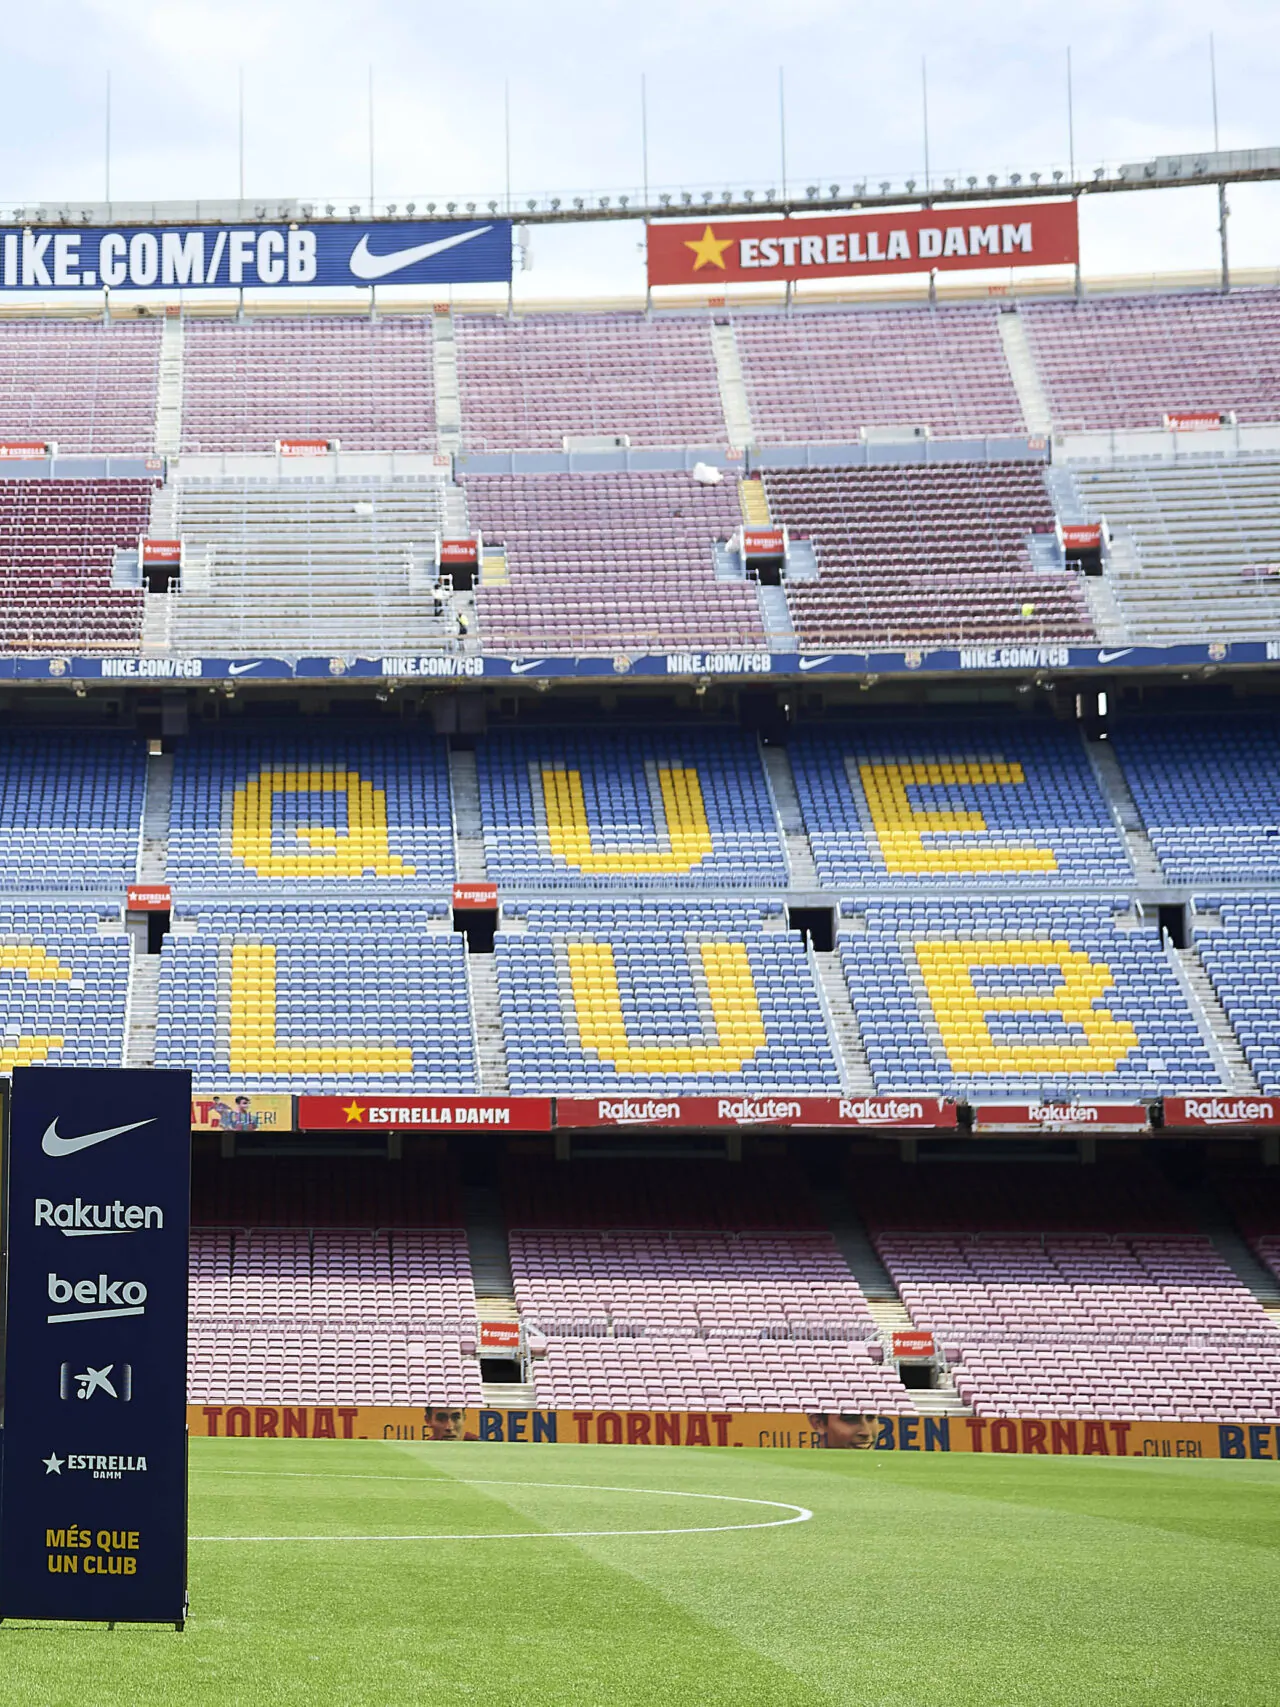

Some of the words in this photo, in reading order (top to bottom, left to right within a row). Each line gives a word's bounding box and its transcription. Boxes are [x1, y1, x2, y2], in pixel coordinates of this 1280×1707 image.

[740, 230, 911, 268] ESTRELLA
[918, 222, 1032, 259] DAMM
[101, 659, 202, 677] NIKE.COM/FCB
[381, 657, 484, 676] NIKE.COM/FCB
[666, 653, 771, 673] NIKE.COM/FCB
[960, 648, 1069, 669] NIKE.COM/FCB
[232, 762, 1058, 877] QUE
[228, 1110, 276, 1125] CULER!
[368, 1107, 451, 1123] ESTRELLA
[455, 1108, 509, 1124] DAMM
[598, 1101, 680, 1119] Rakuten
[718, 1101, 801, 1119] Rakuten
[839, 1100, 923, 1118] Rakuten
[1028, 1105, 1098, 1121] Rakuten
[1185, 1101, 1273, 1119] Rakuten
[35, 1198, 163, 1229] Rakuten
[48, 1273, 147, 1305] beko
[479, 1410, 557, 1443] BEN
[874, 1416, 950, 1451] BEN
[1218, 1425, 1280, 1460] BE
[68, 1455, 147, 1471] ESTRELLA
[93, 1471, 122, 1479] DAMM
[46, 1524, 91, 1548] MÉS
[96, 1530, 140, 1552] QUE
[48, 1555, 77, 1573] UN
[83, 1556, 137, 1575] CLUB
